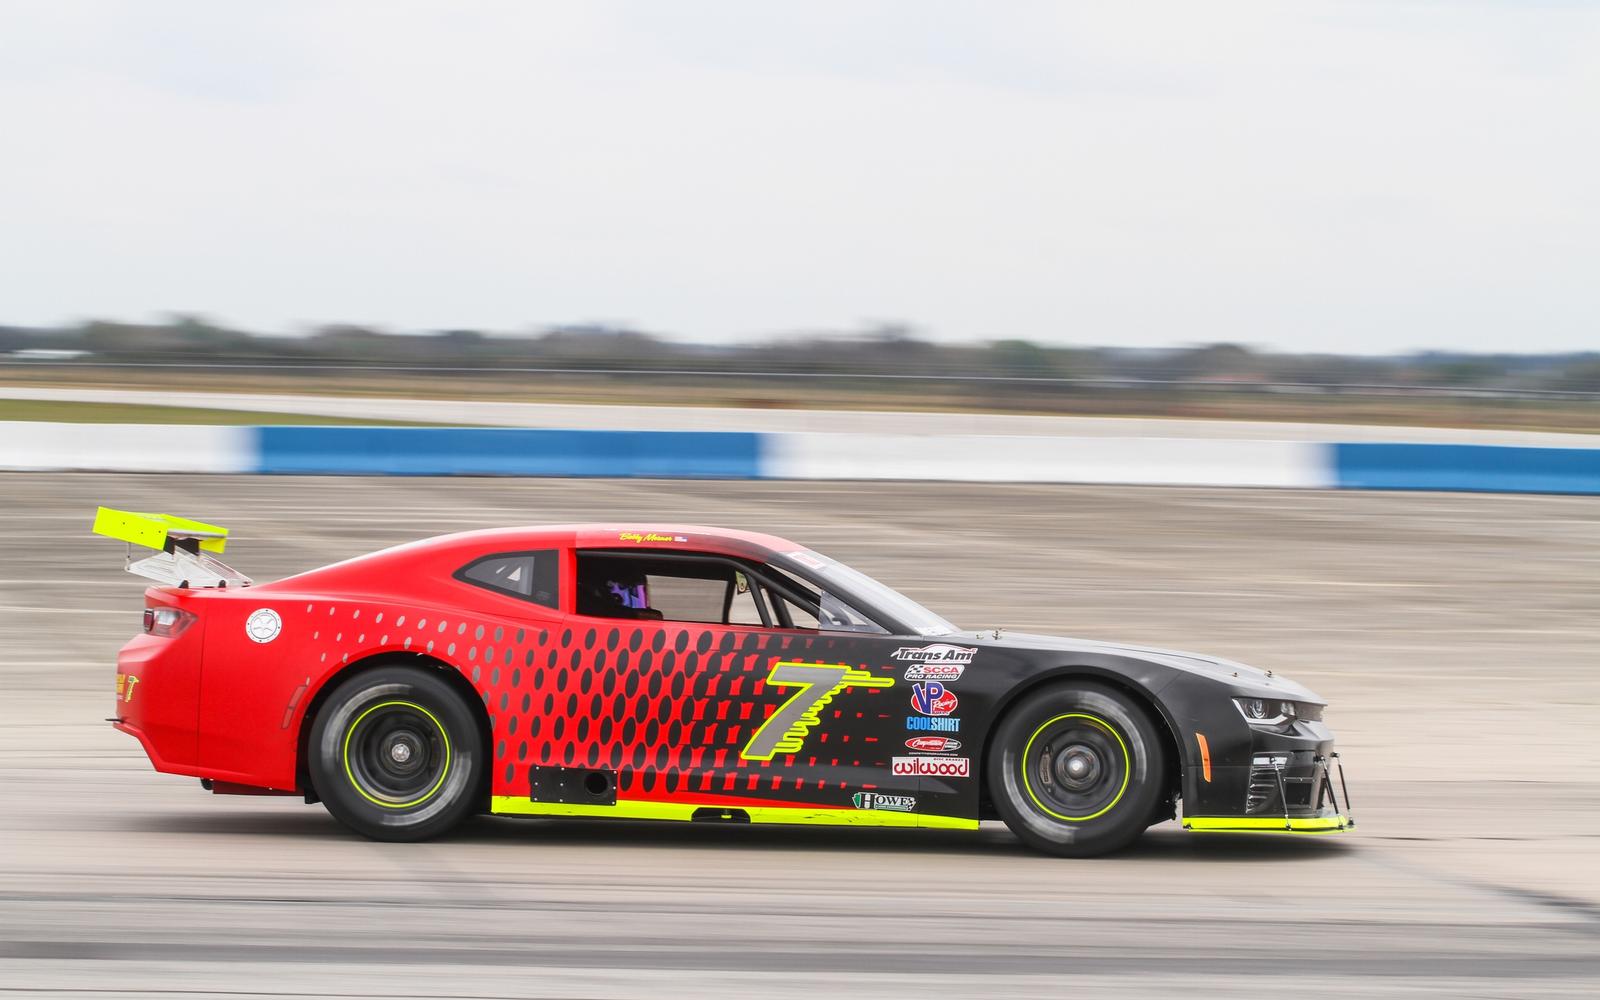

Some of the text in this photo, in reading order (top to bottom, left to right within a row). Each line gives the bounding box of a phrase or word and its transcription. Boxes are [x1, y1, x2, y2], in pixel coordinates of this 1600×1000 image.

[899, 649, 971, 660] Trans Am
[912, 681, 945, 715] VP
[740, 662, 895, 761] 7
[894, 758, 967, 775] wilwood
